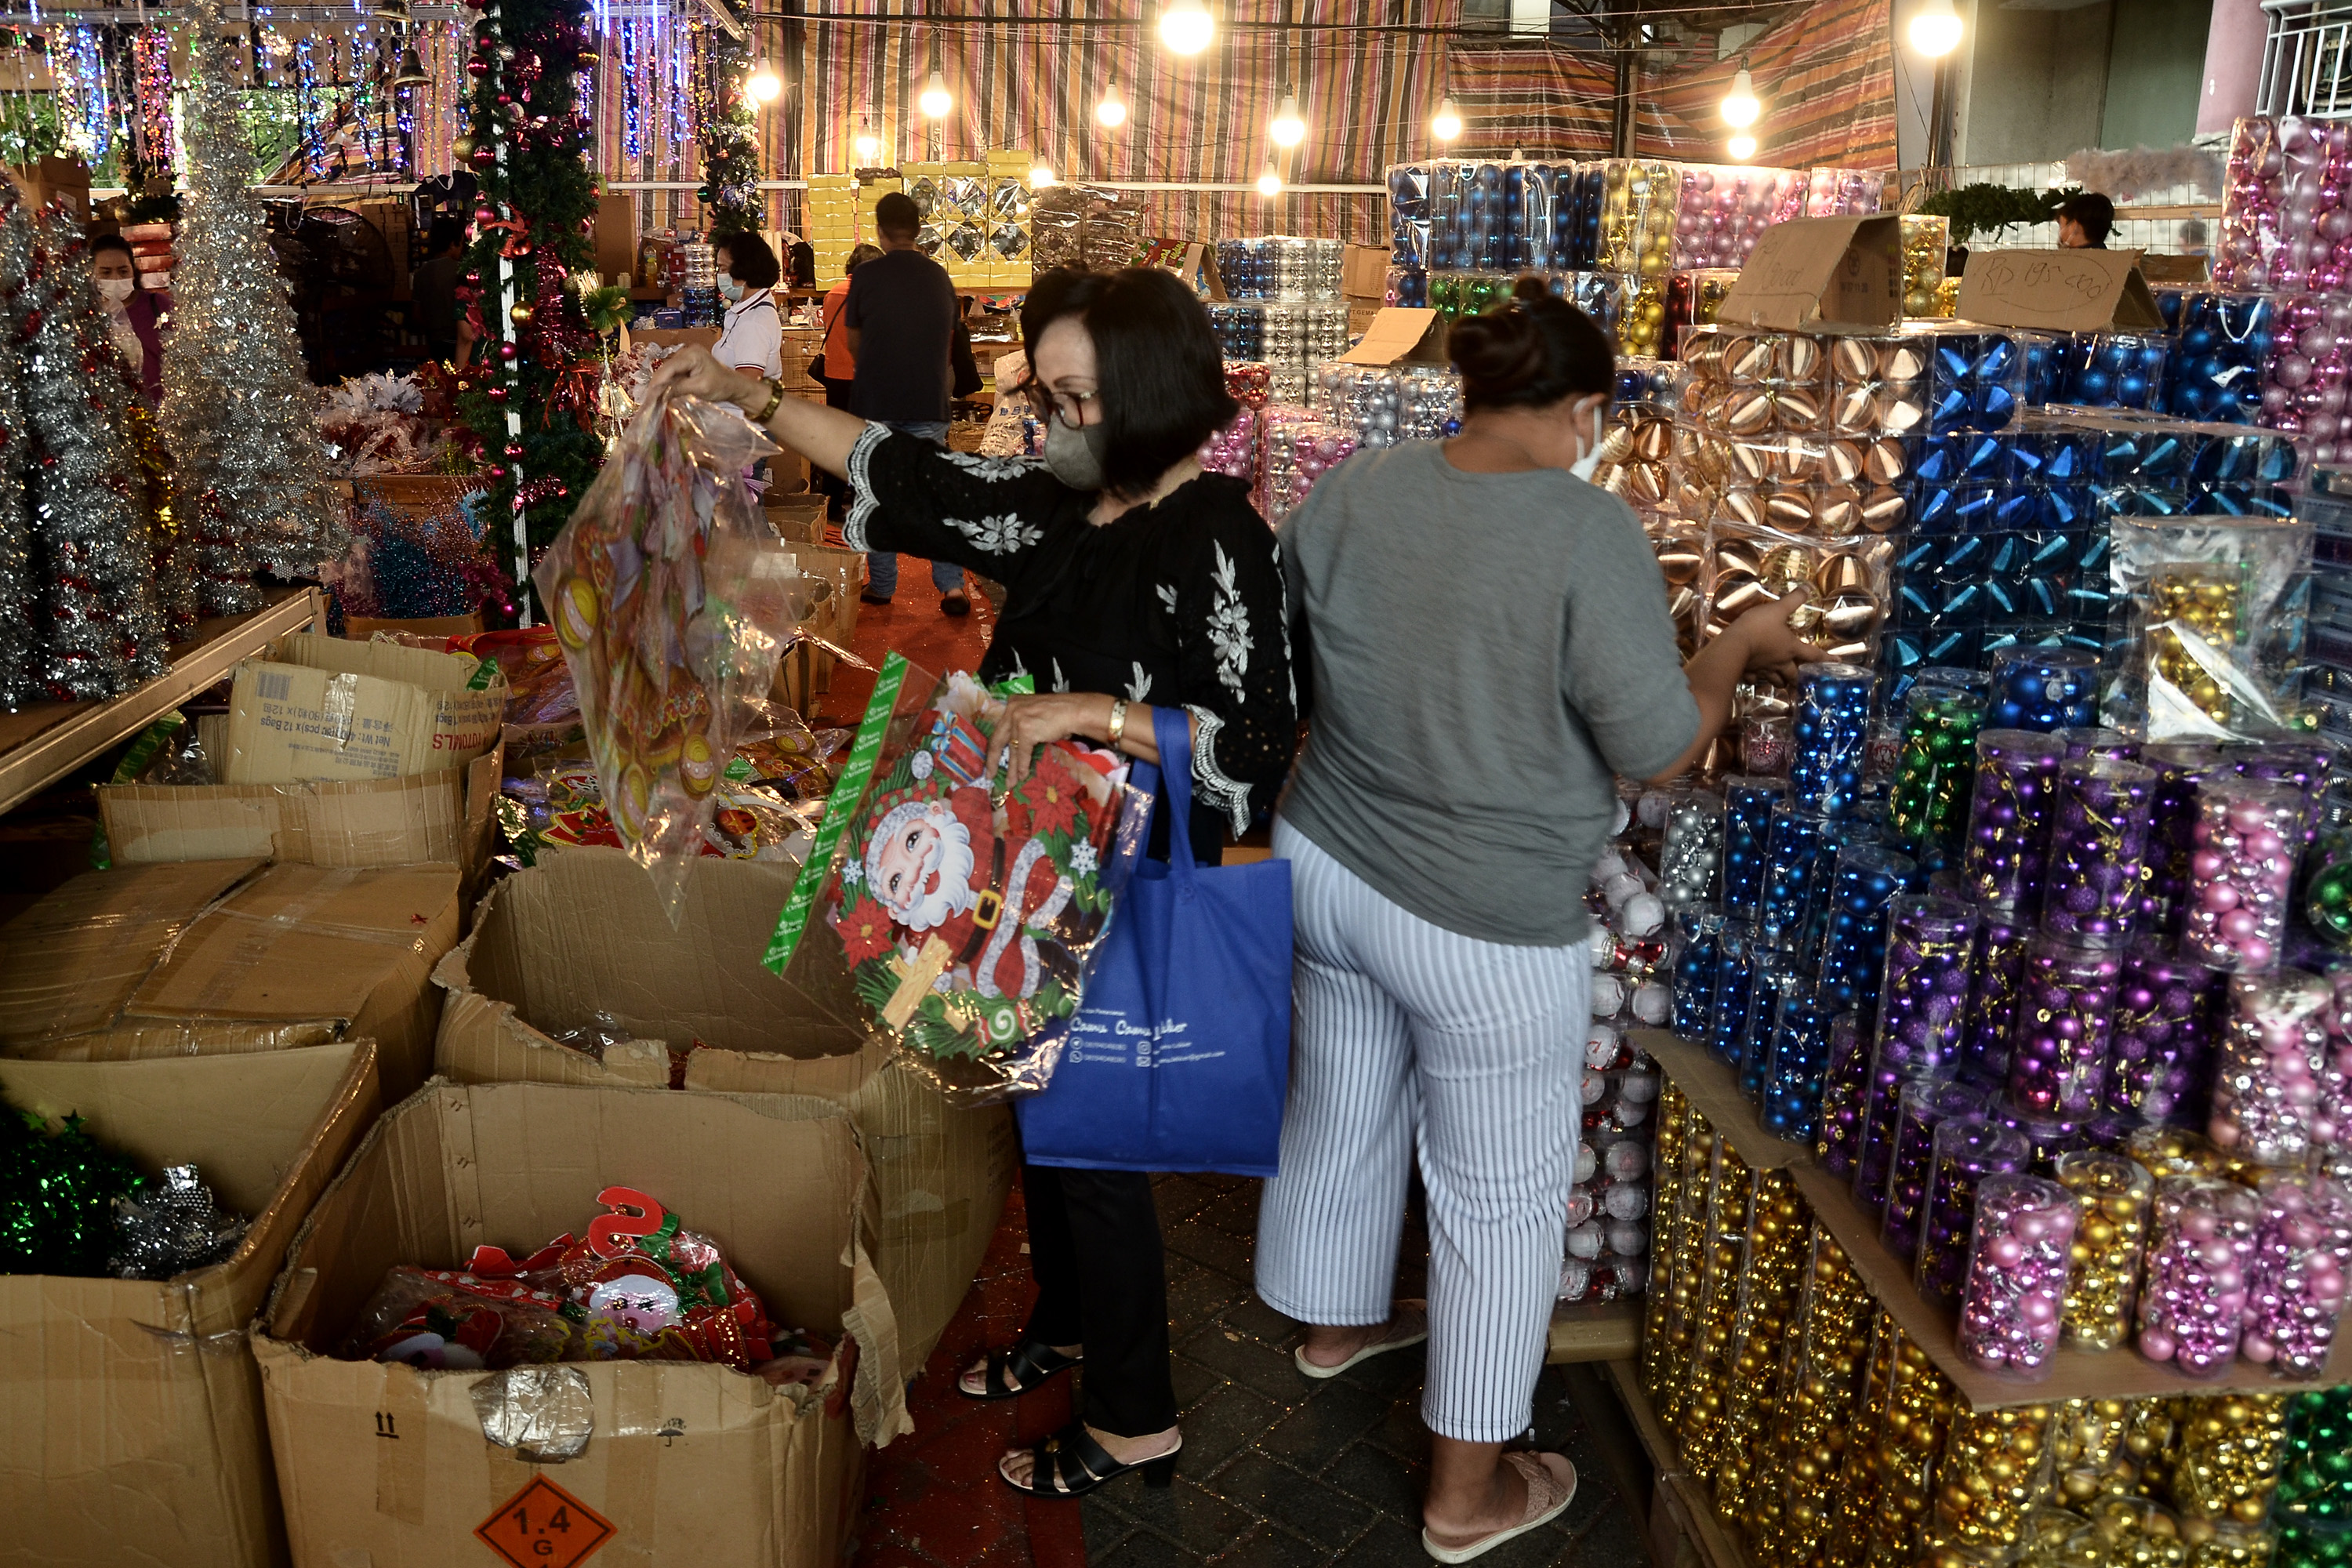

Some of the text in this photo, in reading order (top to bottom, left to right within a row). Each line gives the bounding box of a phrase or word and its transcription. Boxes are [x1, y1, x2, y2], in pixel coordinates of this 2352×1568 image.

[260, 717, 281, 731] Bags
[864, 710, 889, 725] Christmas
[284, 722, 292, 731] 12
[375, 735, 390, 746] Net
[854, 738, 880, 753] Christmas
[844, 765, 871, 779] Christmas
[512, 1505, 572, 1534] 1.4
[532, 1539, 554, 1556] G
